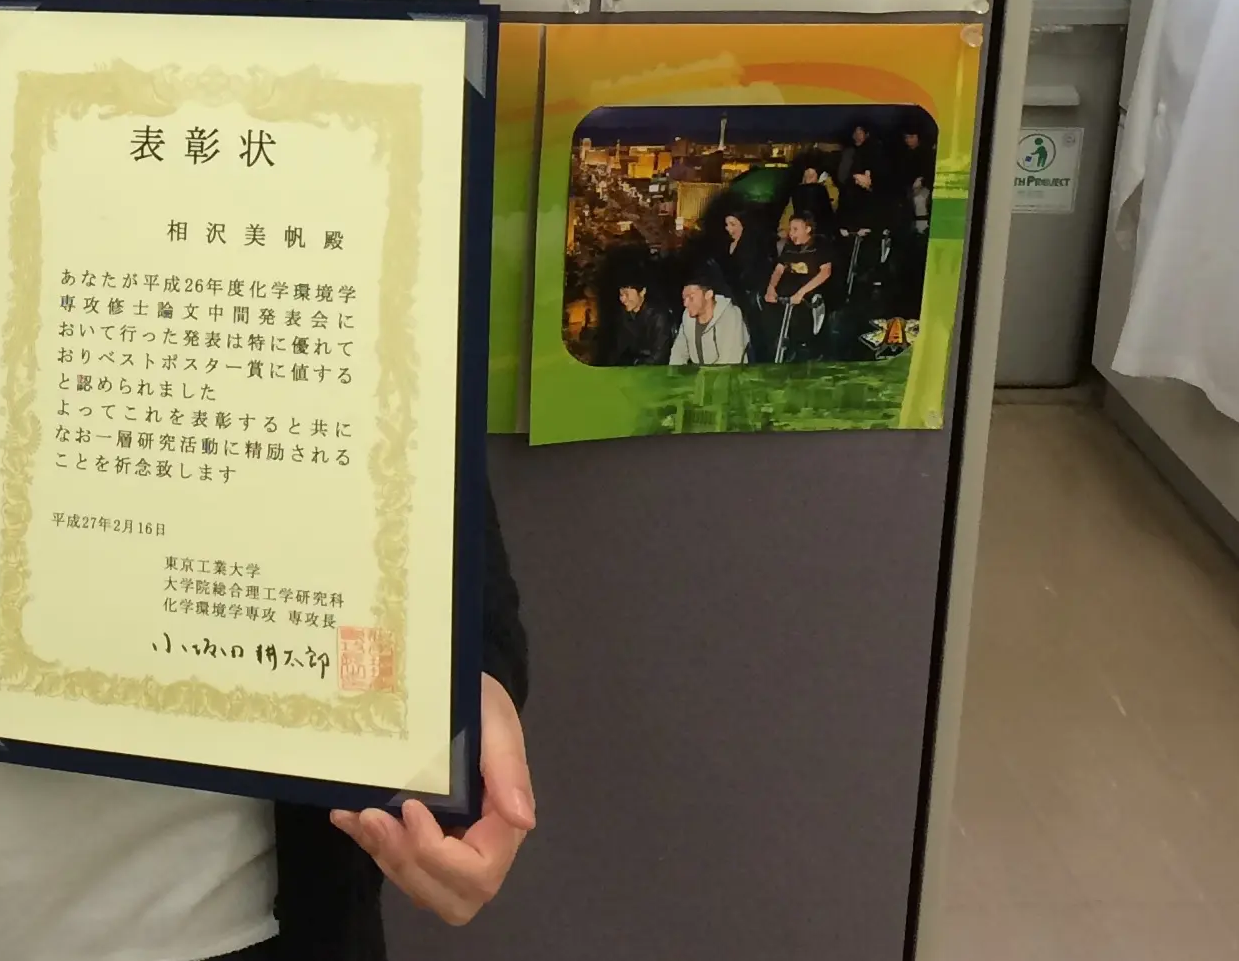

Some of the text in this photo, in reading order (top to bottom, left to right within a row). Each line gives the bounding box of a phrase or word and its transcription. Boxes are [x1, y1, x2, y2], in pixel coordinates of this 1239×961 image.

[130, 124, 277, 169] 表彰状
[166, 219, 345, 251] 相沢美帆殿
[60, 269, 356, 303] あなたが平成26年度化学環境学
[60, 294, 355, 330] 専攻修士論文中間発表会に
[58, 322, 354, 358] おいて行った発表は特に優れて
[57, 347, 353, 385] おりベストポスター賞に値する
[58, 373, 217, 402] と認められました
[57, 401, 352, 438] よってこれを表彰すると共に
[56, 425, 351, 468] なお一層研究活動に精励される
[56, 451, 237, 484] ことを祈念致します
[51, 512, 167, 537] 平成27年2月16日
[163, 555, 261, 579] 東京工業大学
[163, 577, 344, 609] 大学院総合理工学研究科
[163, 597, 338, 629] 化学環境学専攻 専攻長
